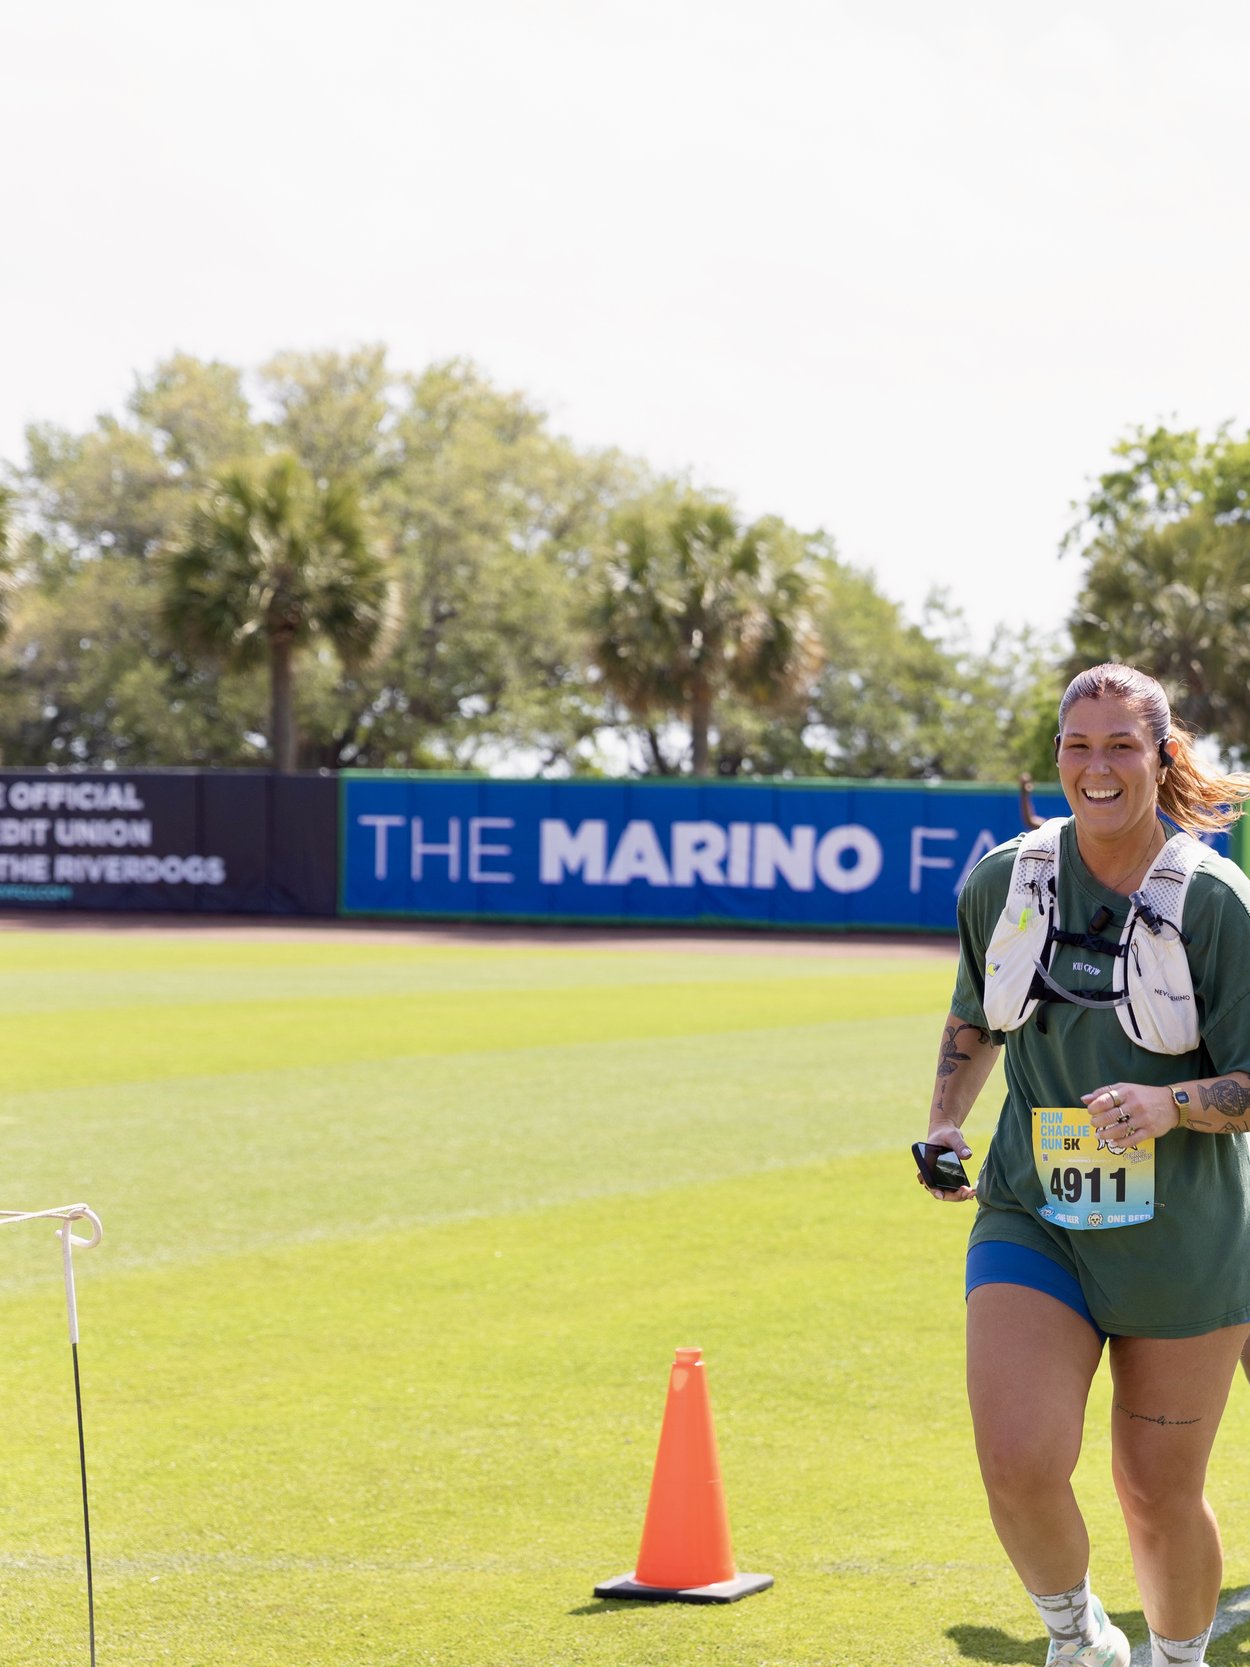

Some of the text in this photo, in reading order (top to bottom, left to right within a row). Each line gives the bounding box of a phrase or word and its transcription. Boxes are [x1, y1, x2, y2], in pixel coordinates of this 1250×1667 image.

[8, 782, 144, 811] OFFICIAL
[54, 818, 153, 847] UNION
[358, 814, 515, 883] THE
[539, 818, 883, 894] MARINO
[53, 854, 226, 885] RIVERDOGS
[1041, 1112, 1063, 1123] RUN
[1041, 1125, 1090, 1136] CHARLIE
[1041, 1138, 1081, 1150] RUN 5K
[1050, 1167, 1126, 1203] 4911
[1107, 1215, 1126, 1223] ONE
